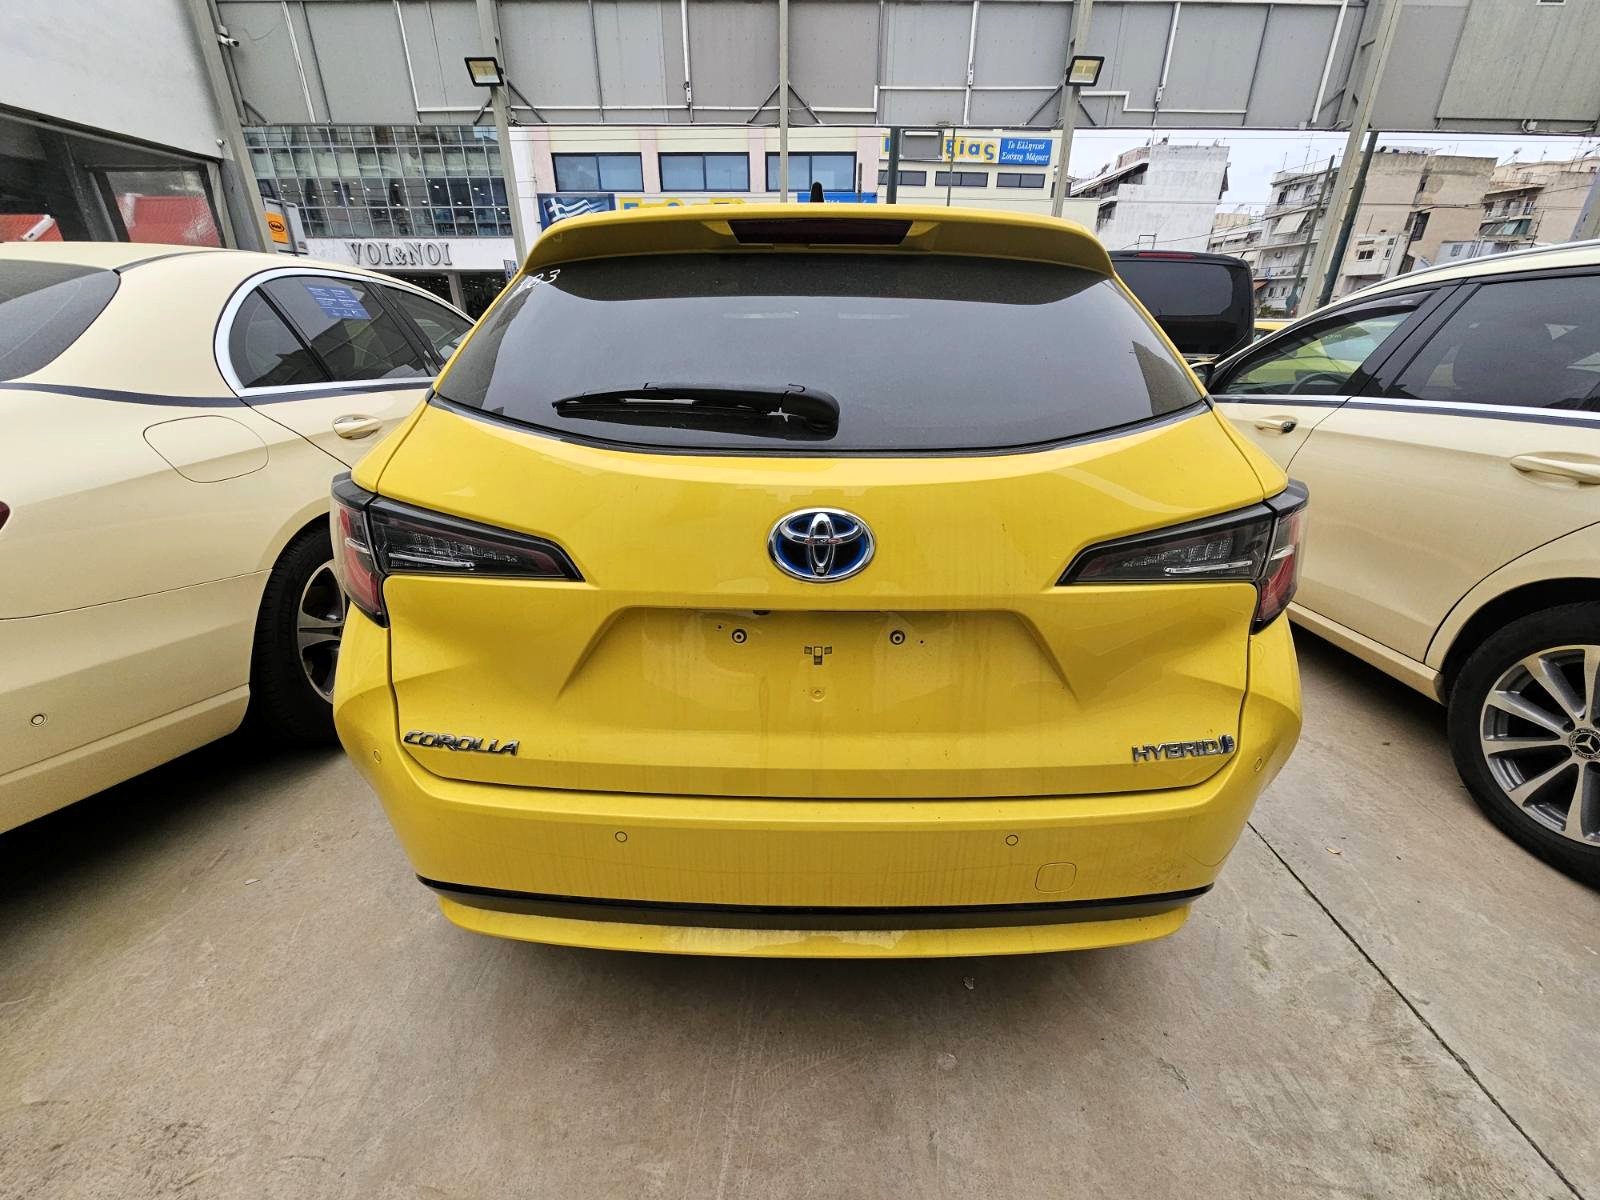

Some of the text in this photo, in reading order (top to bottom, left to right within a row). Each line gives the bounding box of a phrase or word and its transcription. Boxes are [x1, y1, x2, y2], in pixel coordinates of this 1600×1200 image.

[344, 241, 453, 266] VOI&NOI
[403, 729, 520, 756] COROLLA
[1131, 739, 1220, 762] HYBRID
